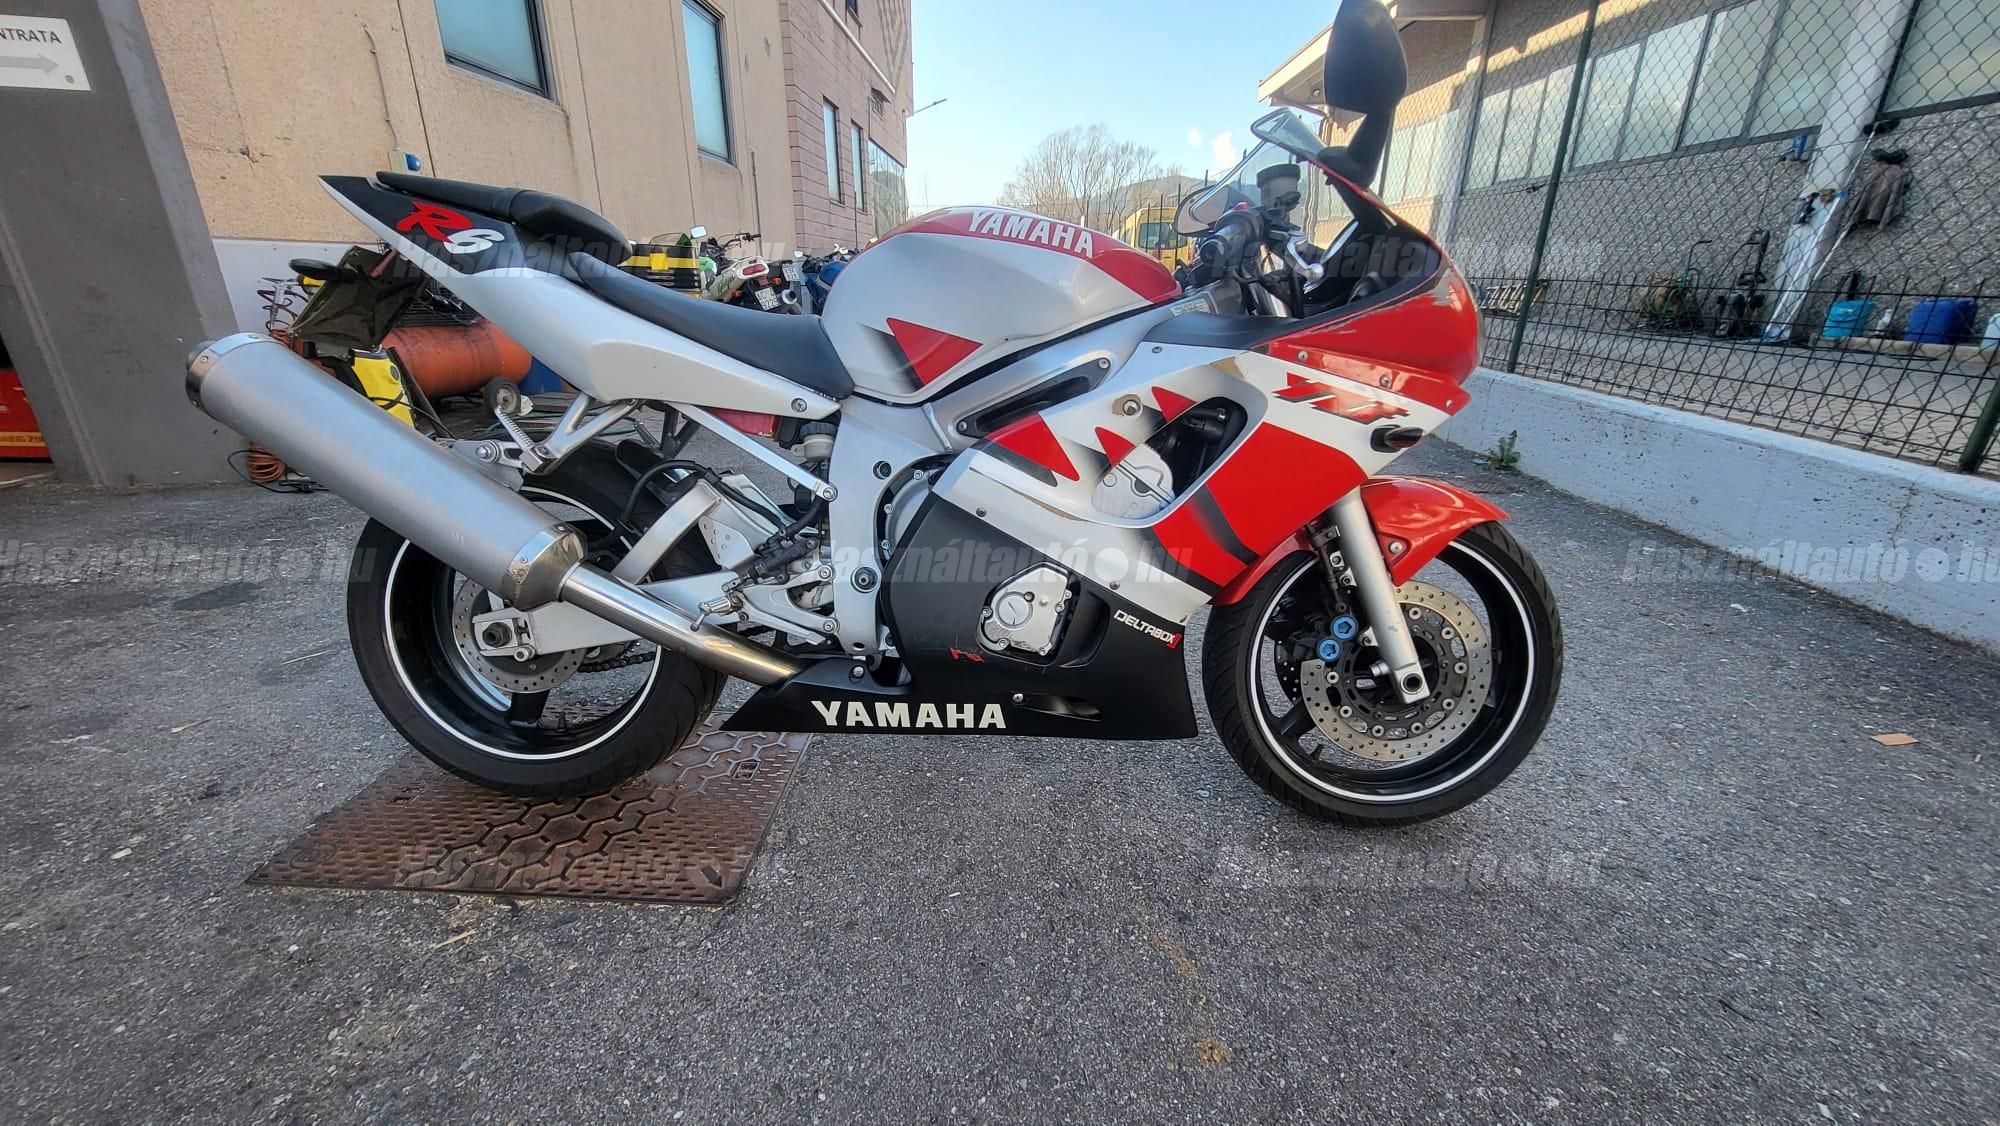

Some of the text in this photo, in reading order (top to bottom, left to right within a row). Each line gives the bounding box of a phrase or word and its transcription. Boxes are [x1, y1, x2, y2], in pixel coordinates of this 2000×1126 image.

[396, 200, 505, 254] R6
[968, 209, 1094, 259] YAMAHA
[811, 700, 1007, 729] YAMAHA
